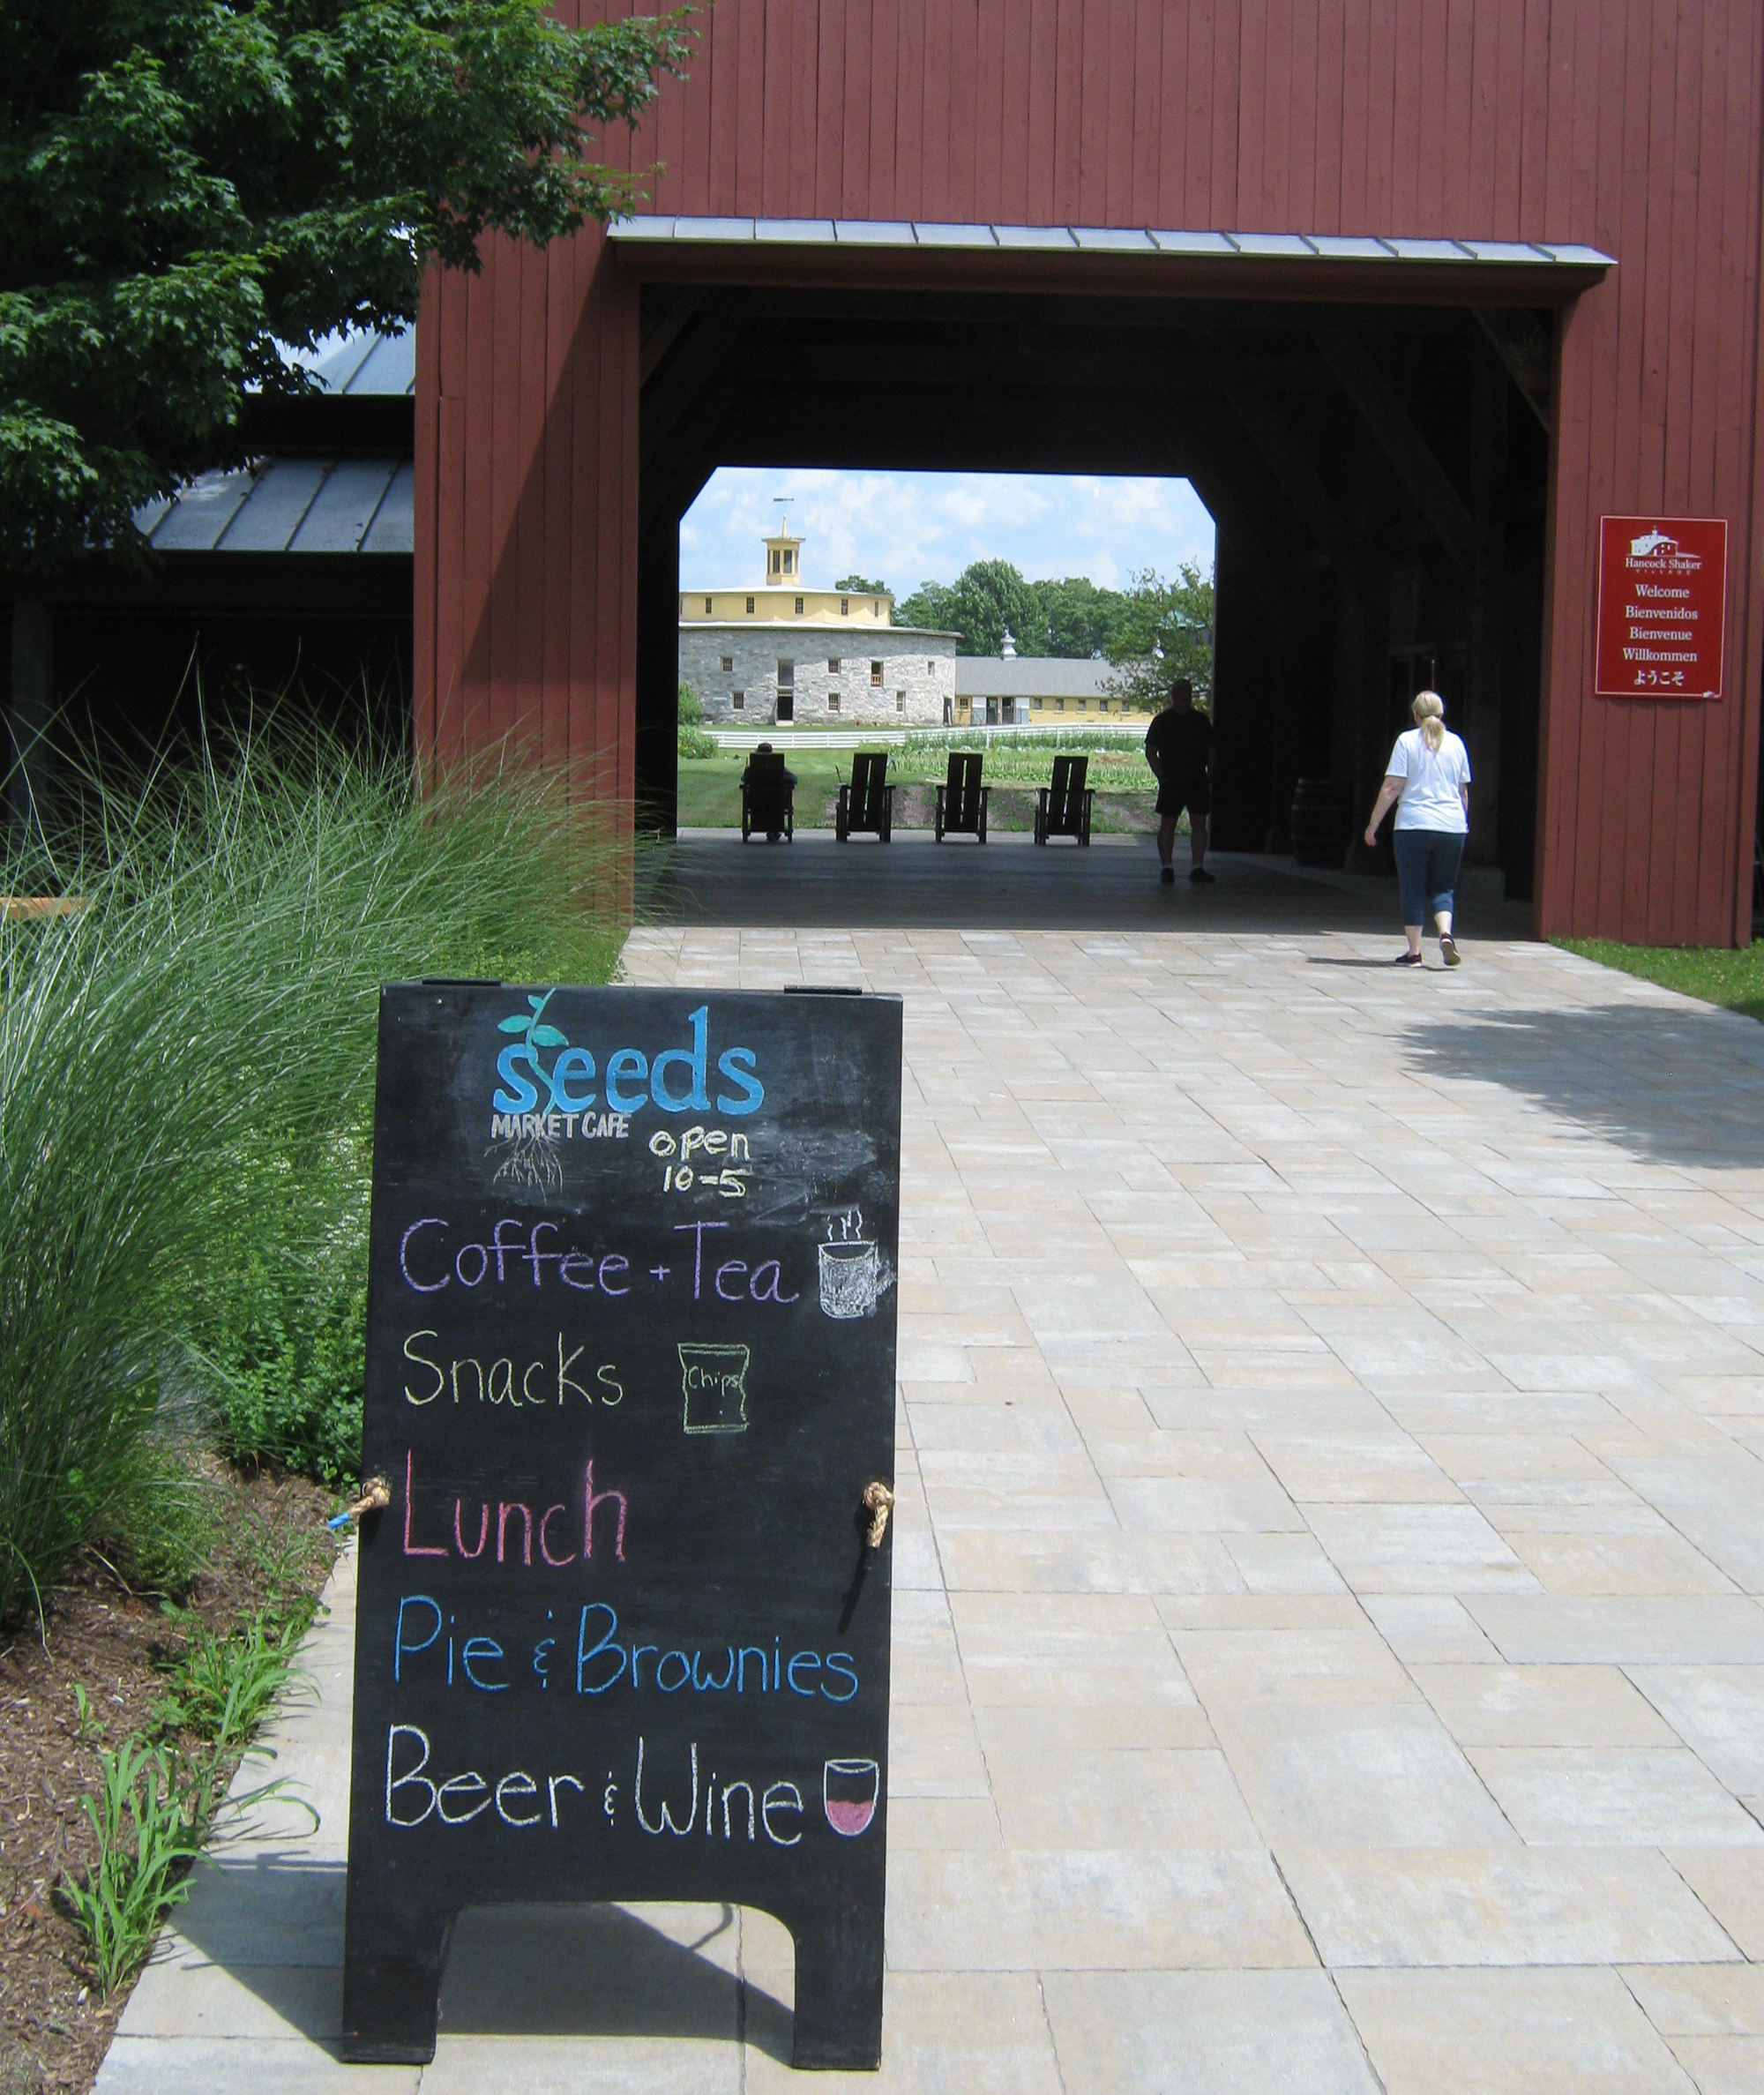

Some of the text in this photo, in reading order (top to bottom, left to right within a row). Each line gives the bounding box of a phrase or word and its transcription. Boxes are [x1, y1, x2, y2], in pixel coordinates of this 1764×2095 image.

[1625, 557, 1701, 570] Hancock Shaker
[1635, 584, 1689, 598] Welcome
[1625, 605, 1698, 620] Bienvenidos
[1629, 626, 1692, 640] Bienvenue
[1622, 647, 1698, 662] Willkommen
[1633, 670, 1684, 686] ようこそ
[490, 1112, 579, 1141] MARKET
[661, 1165, 752, 1199] 10-5
[400, 1218, 800, 1304] Coffee + Tea
[403, 1330, 624, 1408] Snacks
[688, 1365, 741, 1397] Chips
[402, 1449, 627, 1567] Lunch
[393, 1595, 510, 1691] Pie
[576, 1603, 859, 1702] Brownies
[385, 1724, 585, 1828] Beer
[634, 1736, 804, 1845] Wine
